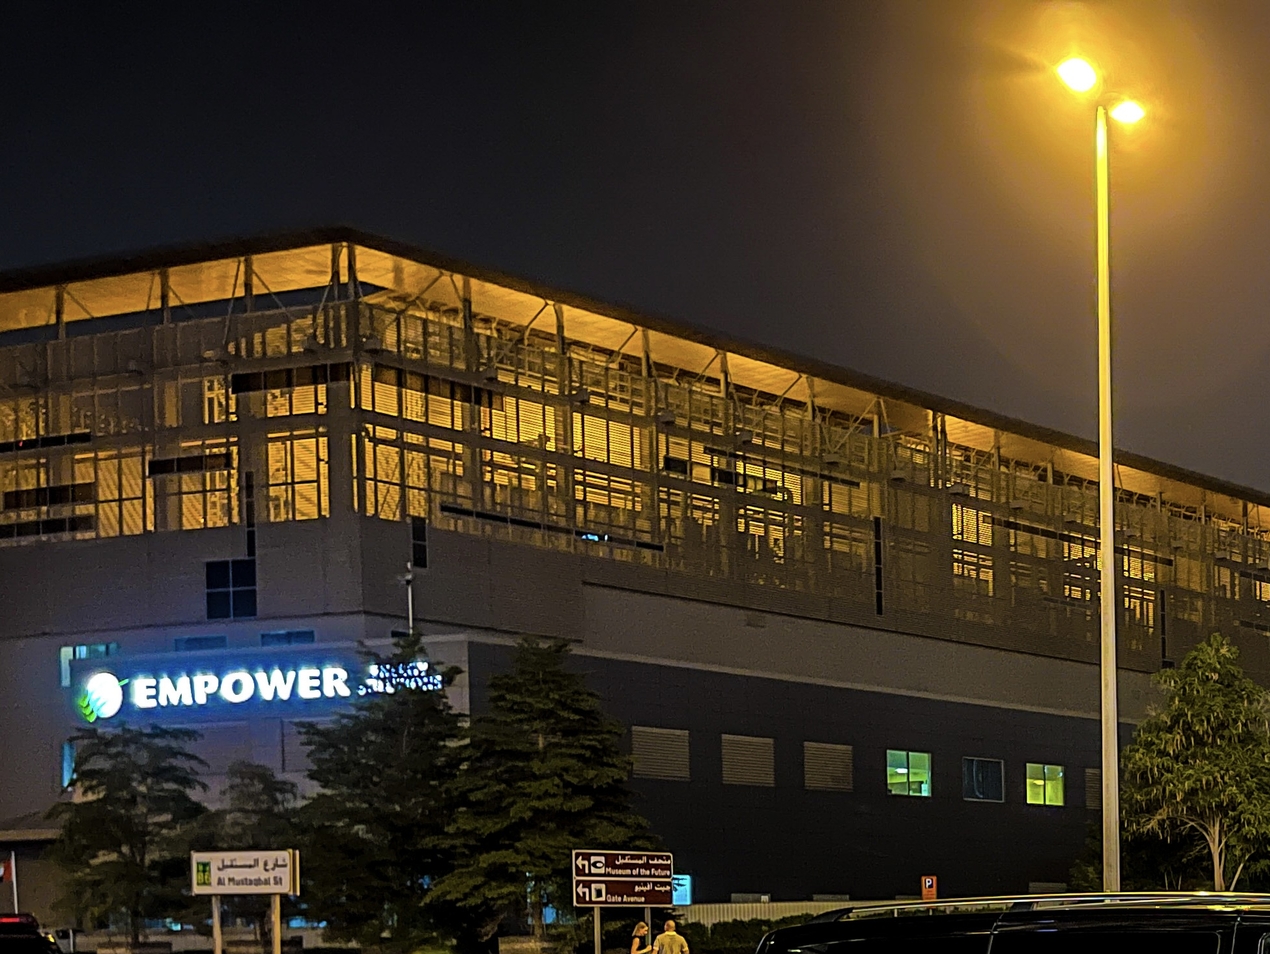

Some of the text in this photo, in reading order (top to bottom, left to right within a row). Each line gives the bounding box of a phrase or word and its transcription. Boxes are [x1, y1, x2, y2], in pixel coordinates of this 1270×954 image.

[133, 666, 351, 708] EMPOWER
[263, 857, 288, 872] شارع
[615, 855, 671, 865] متحف المستقبل
[605, 867, 670, 876] Museum of the Future
[217, 876, 226, 887] Al
[273, 875, 283, 887] St
[925, 878, 933, 889] P
[606, 894, 645, 903] Gate Avenue
